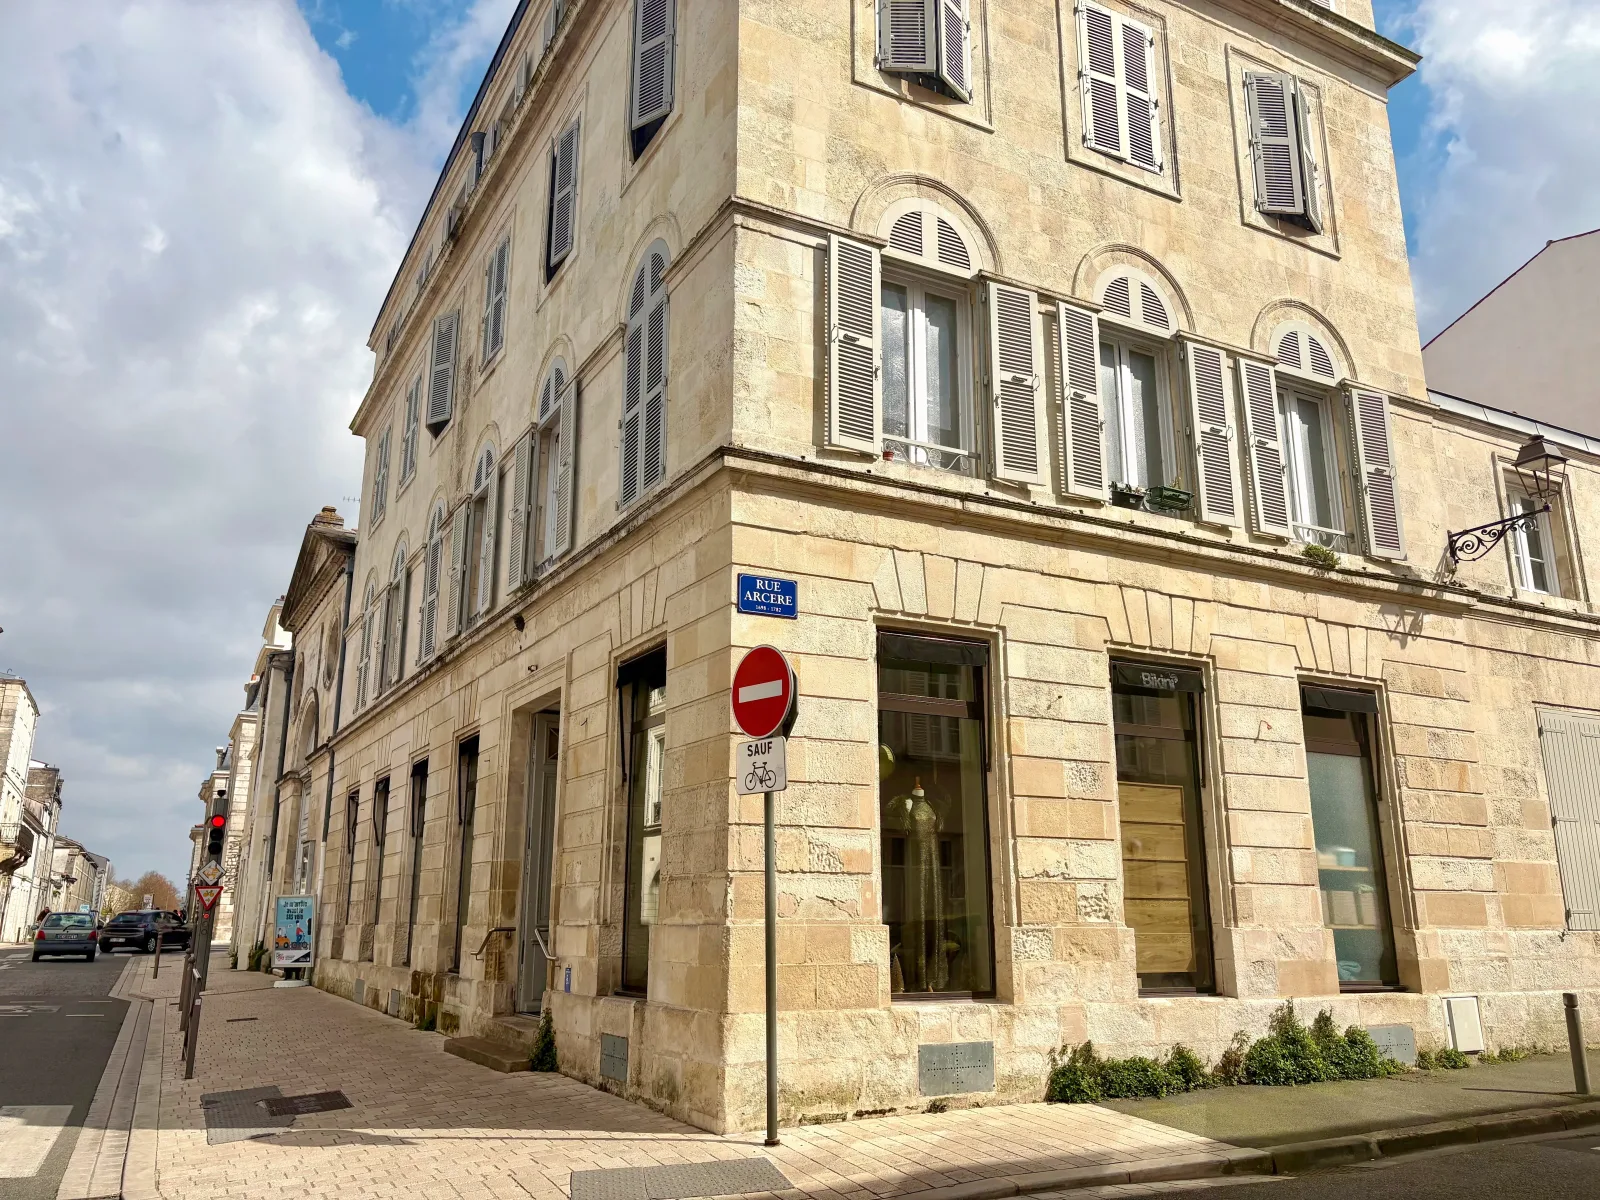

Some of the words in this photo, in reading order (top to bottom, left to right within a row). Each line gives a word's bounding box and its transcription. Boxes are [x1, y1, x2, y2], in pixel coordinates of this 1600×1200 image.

[756, 579, 781, 592] RUE
[744, 590, 793, 606] ARCERE
[747, 741, 773, 757] SAUF
